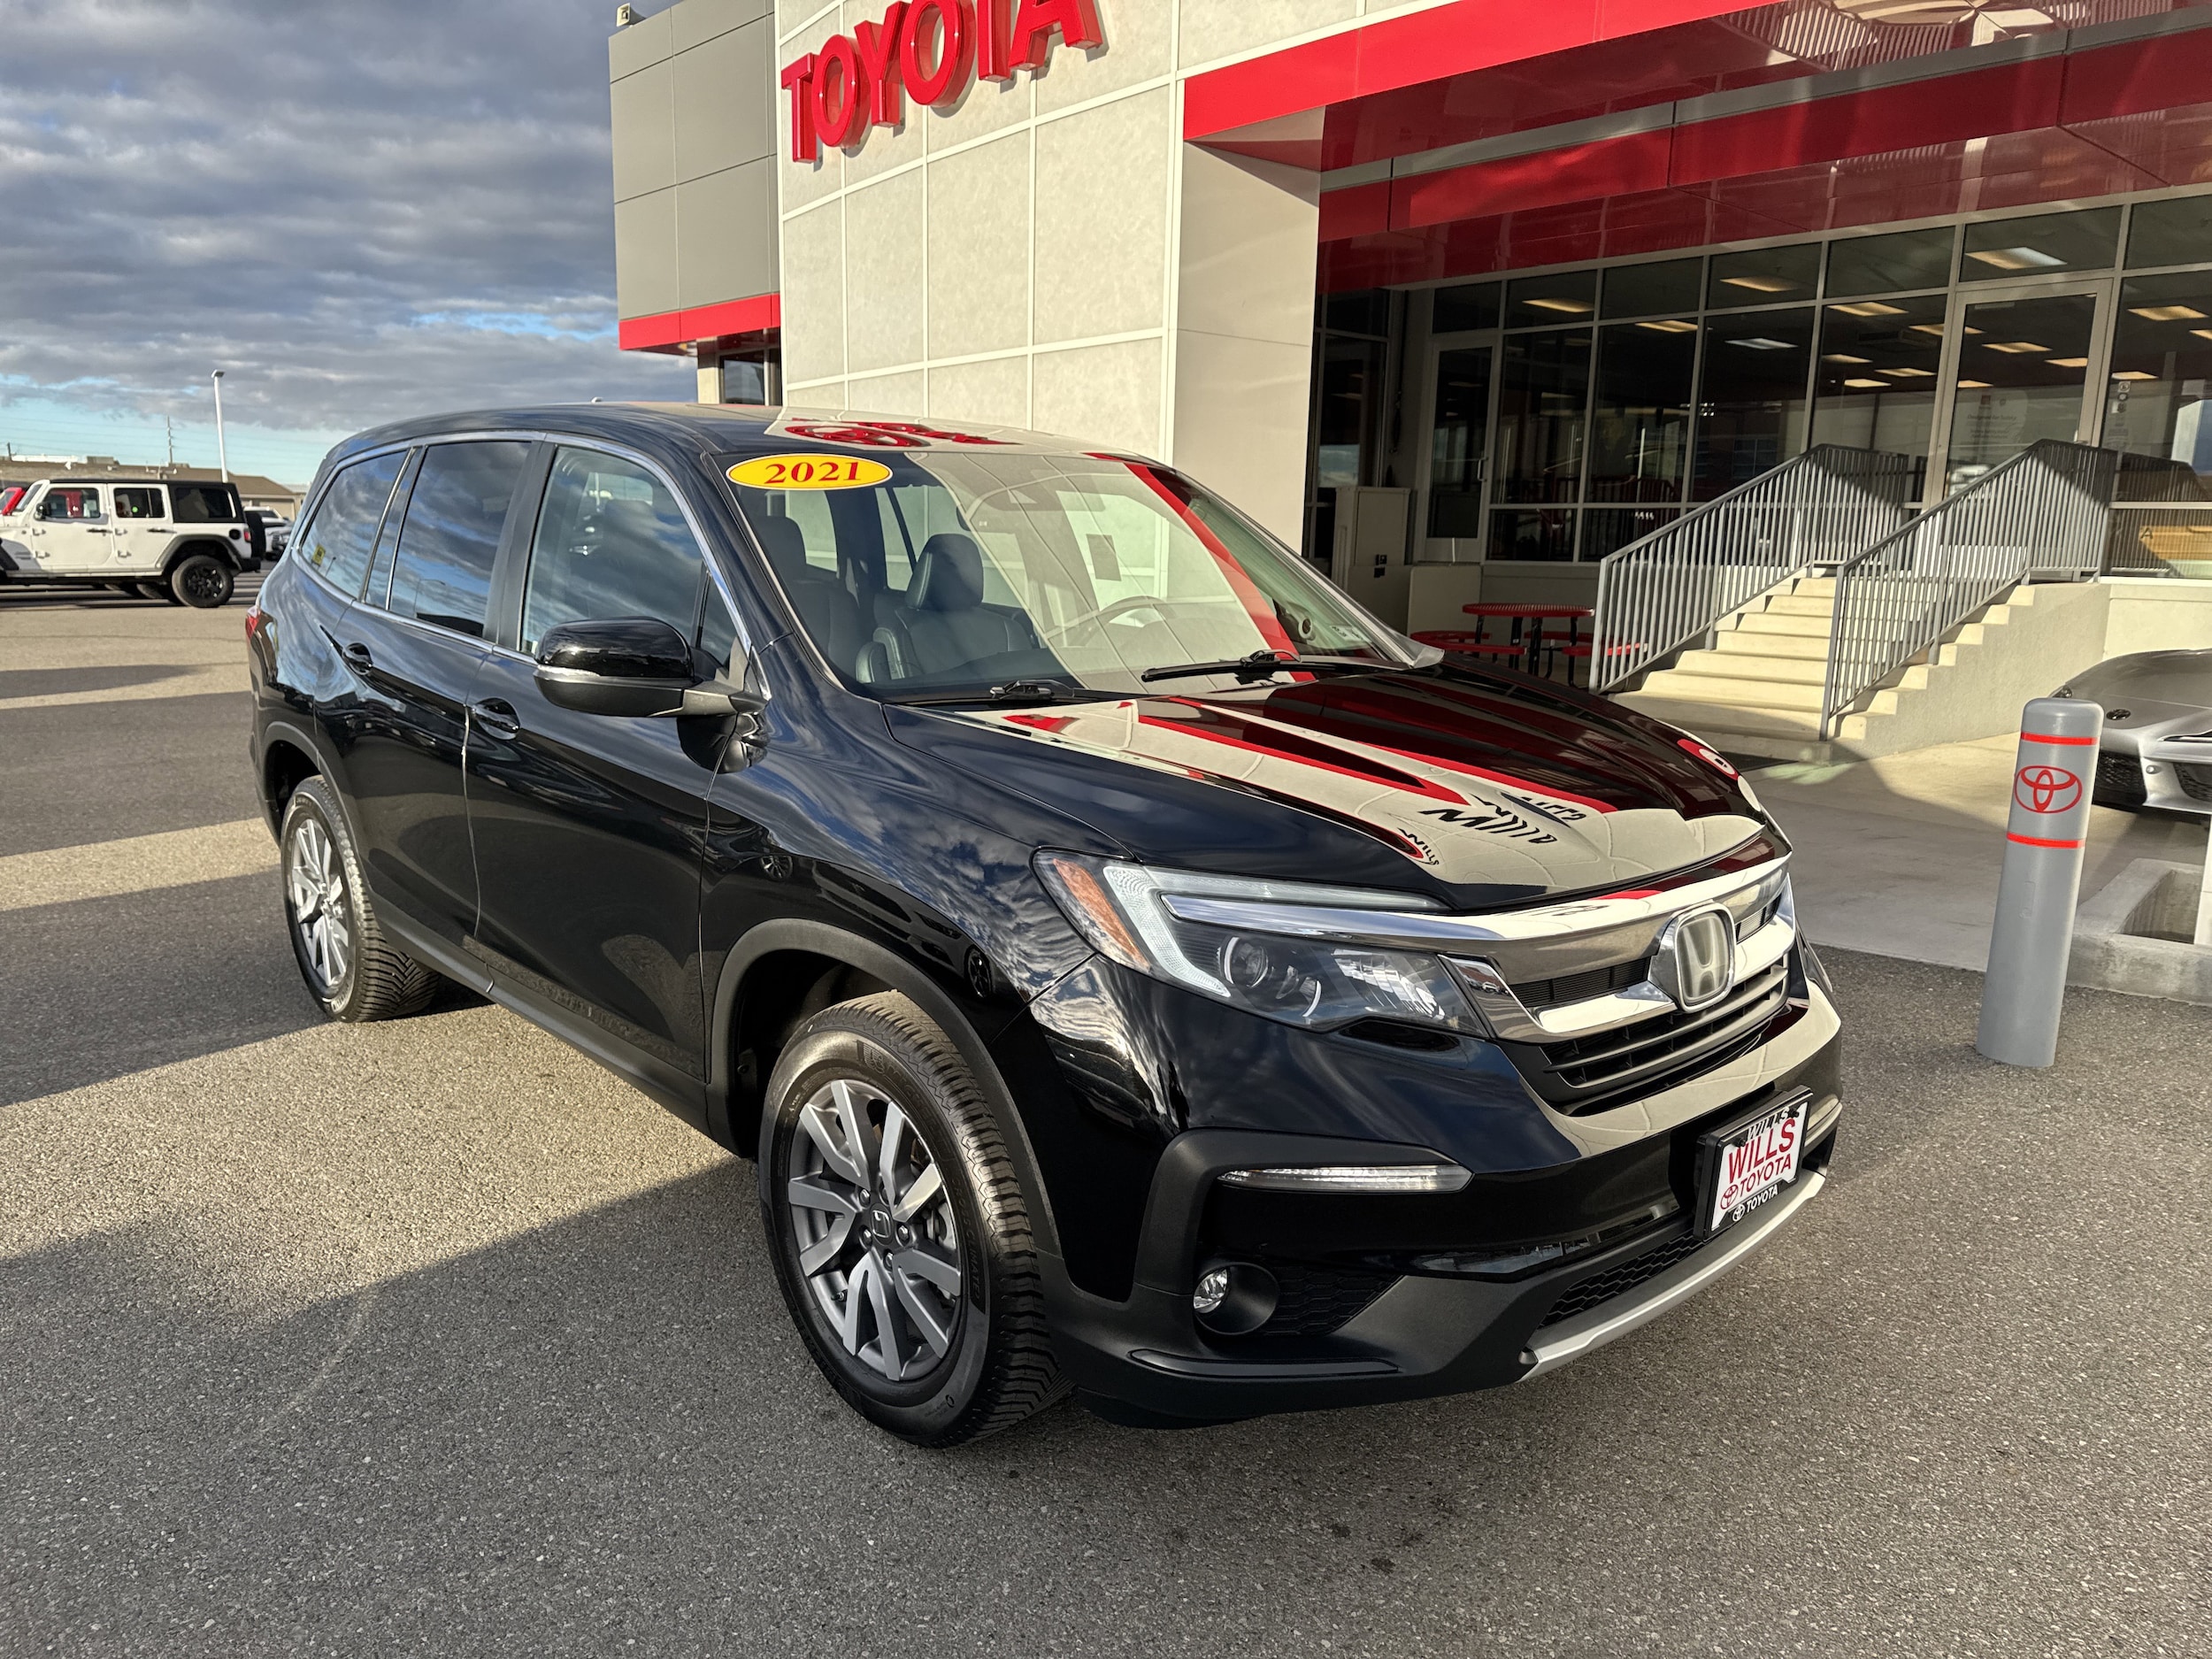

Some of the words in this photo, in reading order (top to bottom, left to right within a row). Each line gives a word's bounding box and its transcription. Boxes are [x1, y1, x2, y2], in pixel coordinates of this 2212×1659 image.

[764, 461, 862, 484] 2021
[1728, 1118, 1796, 1184] WILLS
[1740, 1153, 1792, 1197] TOYOTA
[1746, 1184, 1778, 1213] TOYOTA
